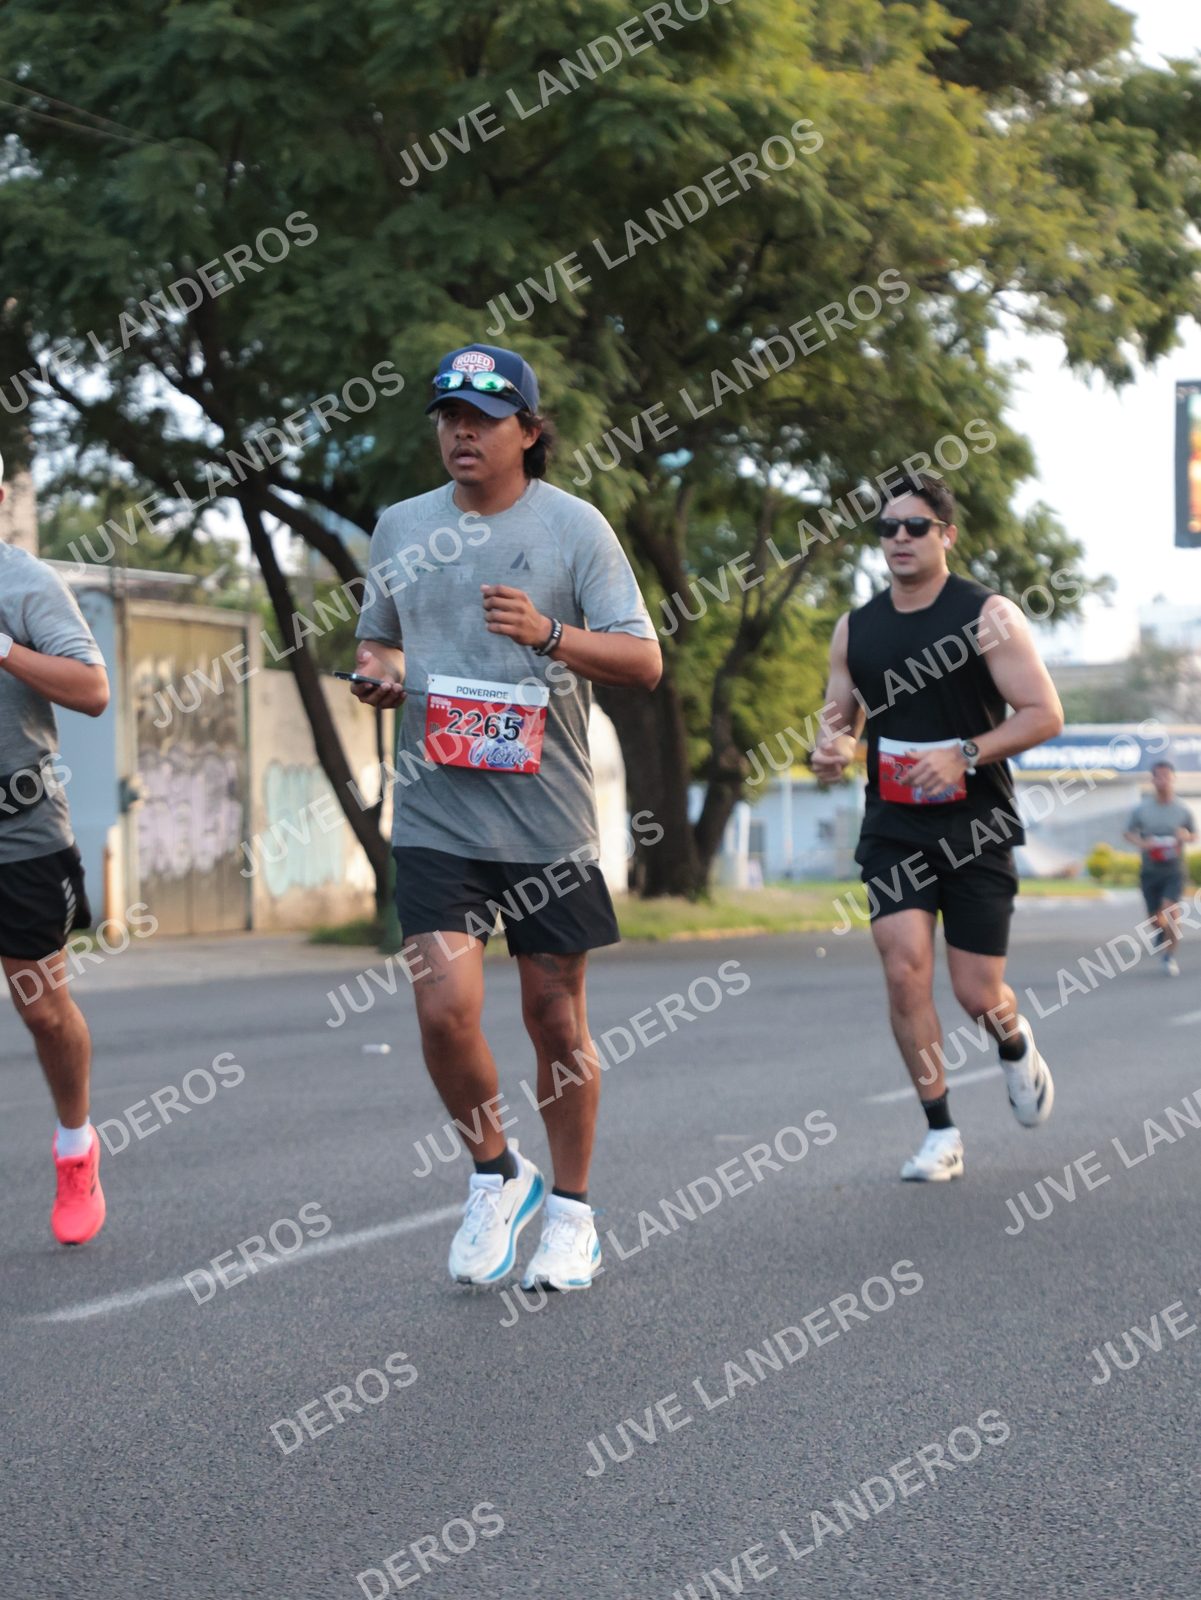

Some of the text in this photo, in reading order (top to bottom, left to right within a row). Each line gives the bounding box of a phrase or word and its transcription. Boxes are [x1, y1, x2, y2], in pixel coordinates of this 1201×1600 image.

[456, 354, 491, 367] RODEO
[456, 685, 509, 700] POWERADE
[446, 708, 521, 740] 2265
